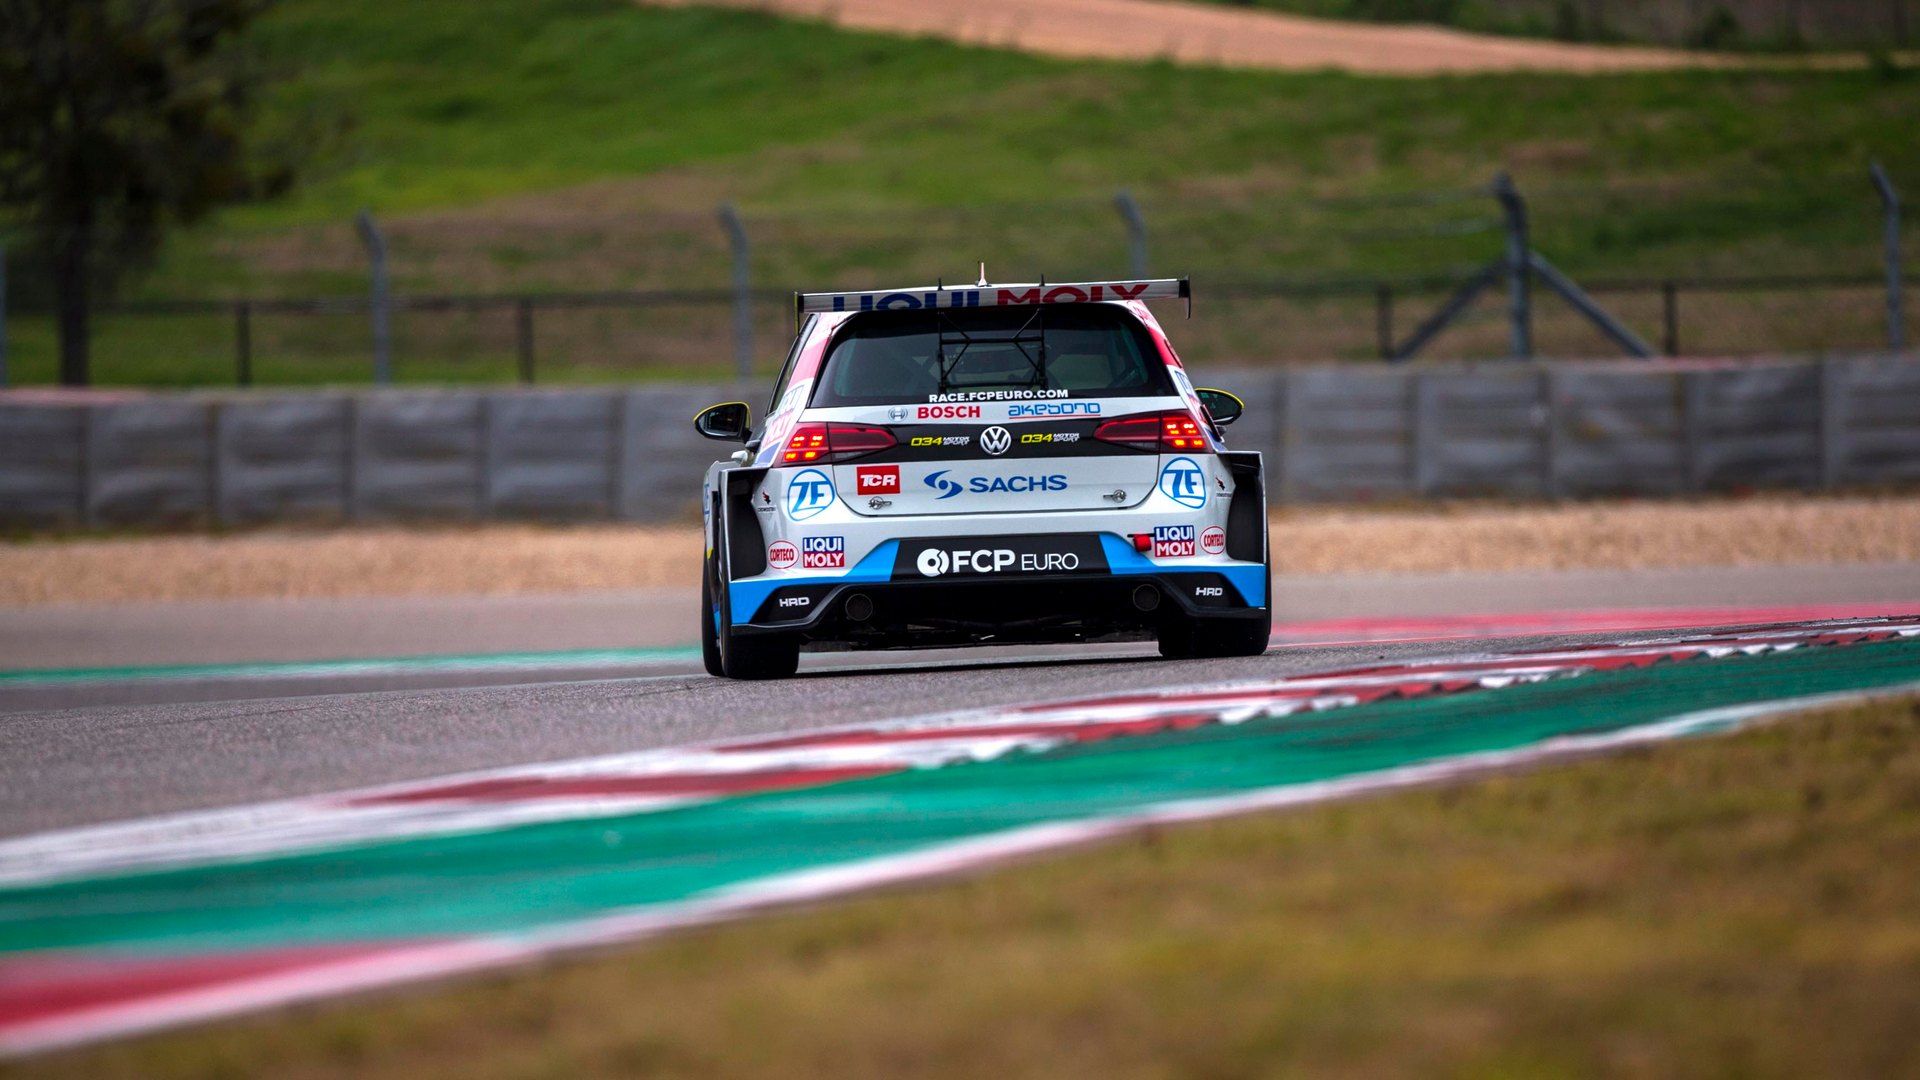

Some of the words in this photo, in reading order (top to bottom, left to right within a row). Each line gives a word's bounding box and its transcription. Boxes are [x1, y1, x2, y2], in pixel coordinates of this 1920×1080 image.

[929, 389, 1069, 403] RACE.FCPEURO.COM
[917, 405, 981, 419] BOSCH
[1008, 402, 1101, 416] akebono
[911, 436, 943, 446] 034
[1021, 433, 1053, 443] 034
[860, 473, 897, 488] TCR
[969, 474, 1068, 493] SACHS
[1163, 469, 1206, 499] ZF
[791, 480, 830, 513] ZF
[1155, 526, 1194, 541] LIQUI
[804, 537, 842, 552] LIQUI
[1156, 541, 1194, 556] MOLY
[770, 548, 794, 561] CORTECO
[804, 553, 843, 567] MOLY
[953, 550, 1016, 572] FCP
[1021, 552, 1079, 571] EURO
[1195, 587, 1224, 596] HRD
[779, 596, 811, 607] HRD
